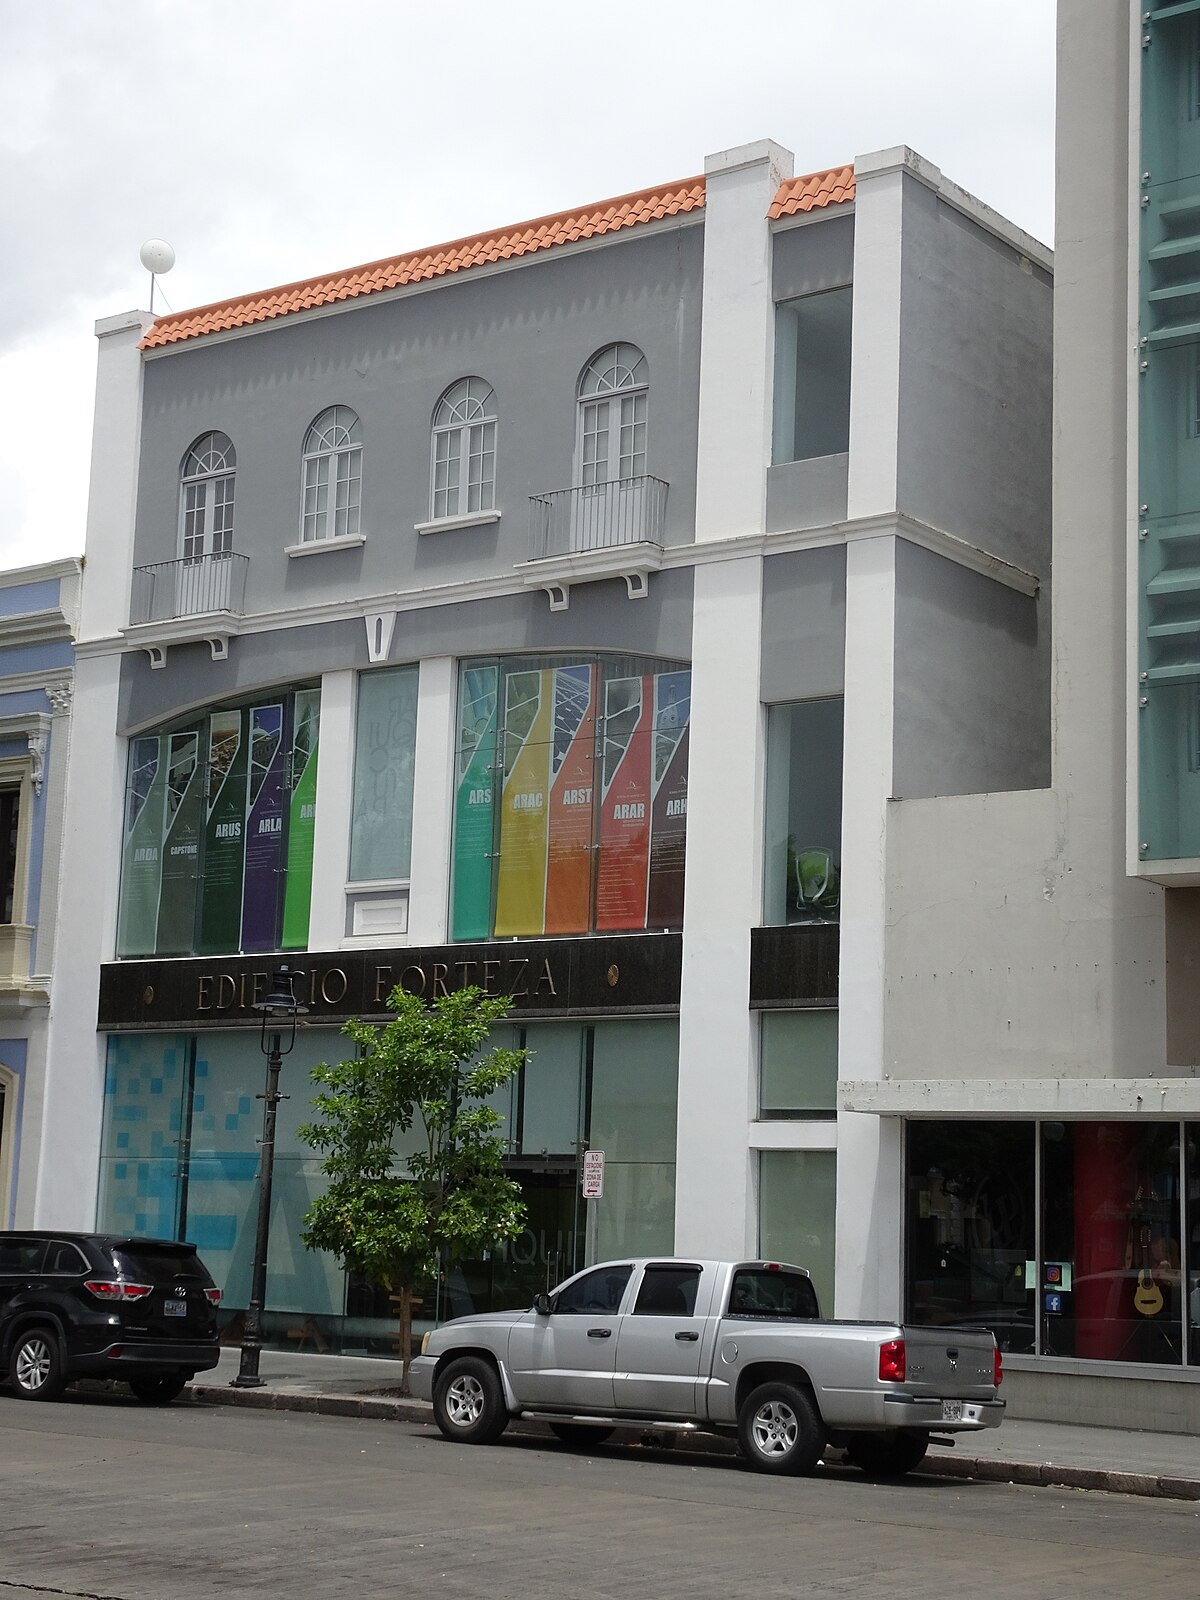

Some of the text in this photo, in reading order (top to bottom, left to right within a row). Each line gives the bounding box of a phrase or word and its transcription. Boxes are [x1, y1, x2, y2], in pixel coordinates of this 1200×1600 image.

[513, 792, 543, 809] ARAC
[562, 788, 593, 805] ARST
[613, 802, 645, 820] ARAR
[215, 822, 241, 838] ARUS
[258, 817, 282, 833] ARLA
[170, 845, 198, 856] CAPSTONE
[196, 957, 557, 1010] EDIFIO FORTEZA
